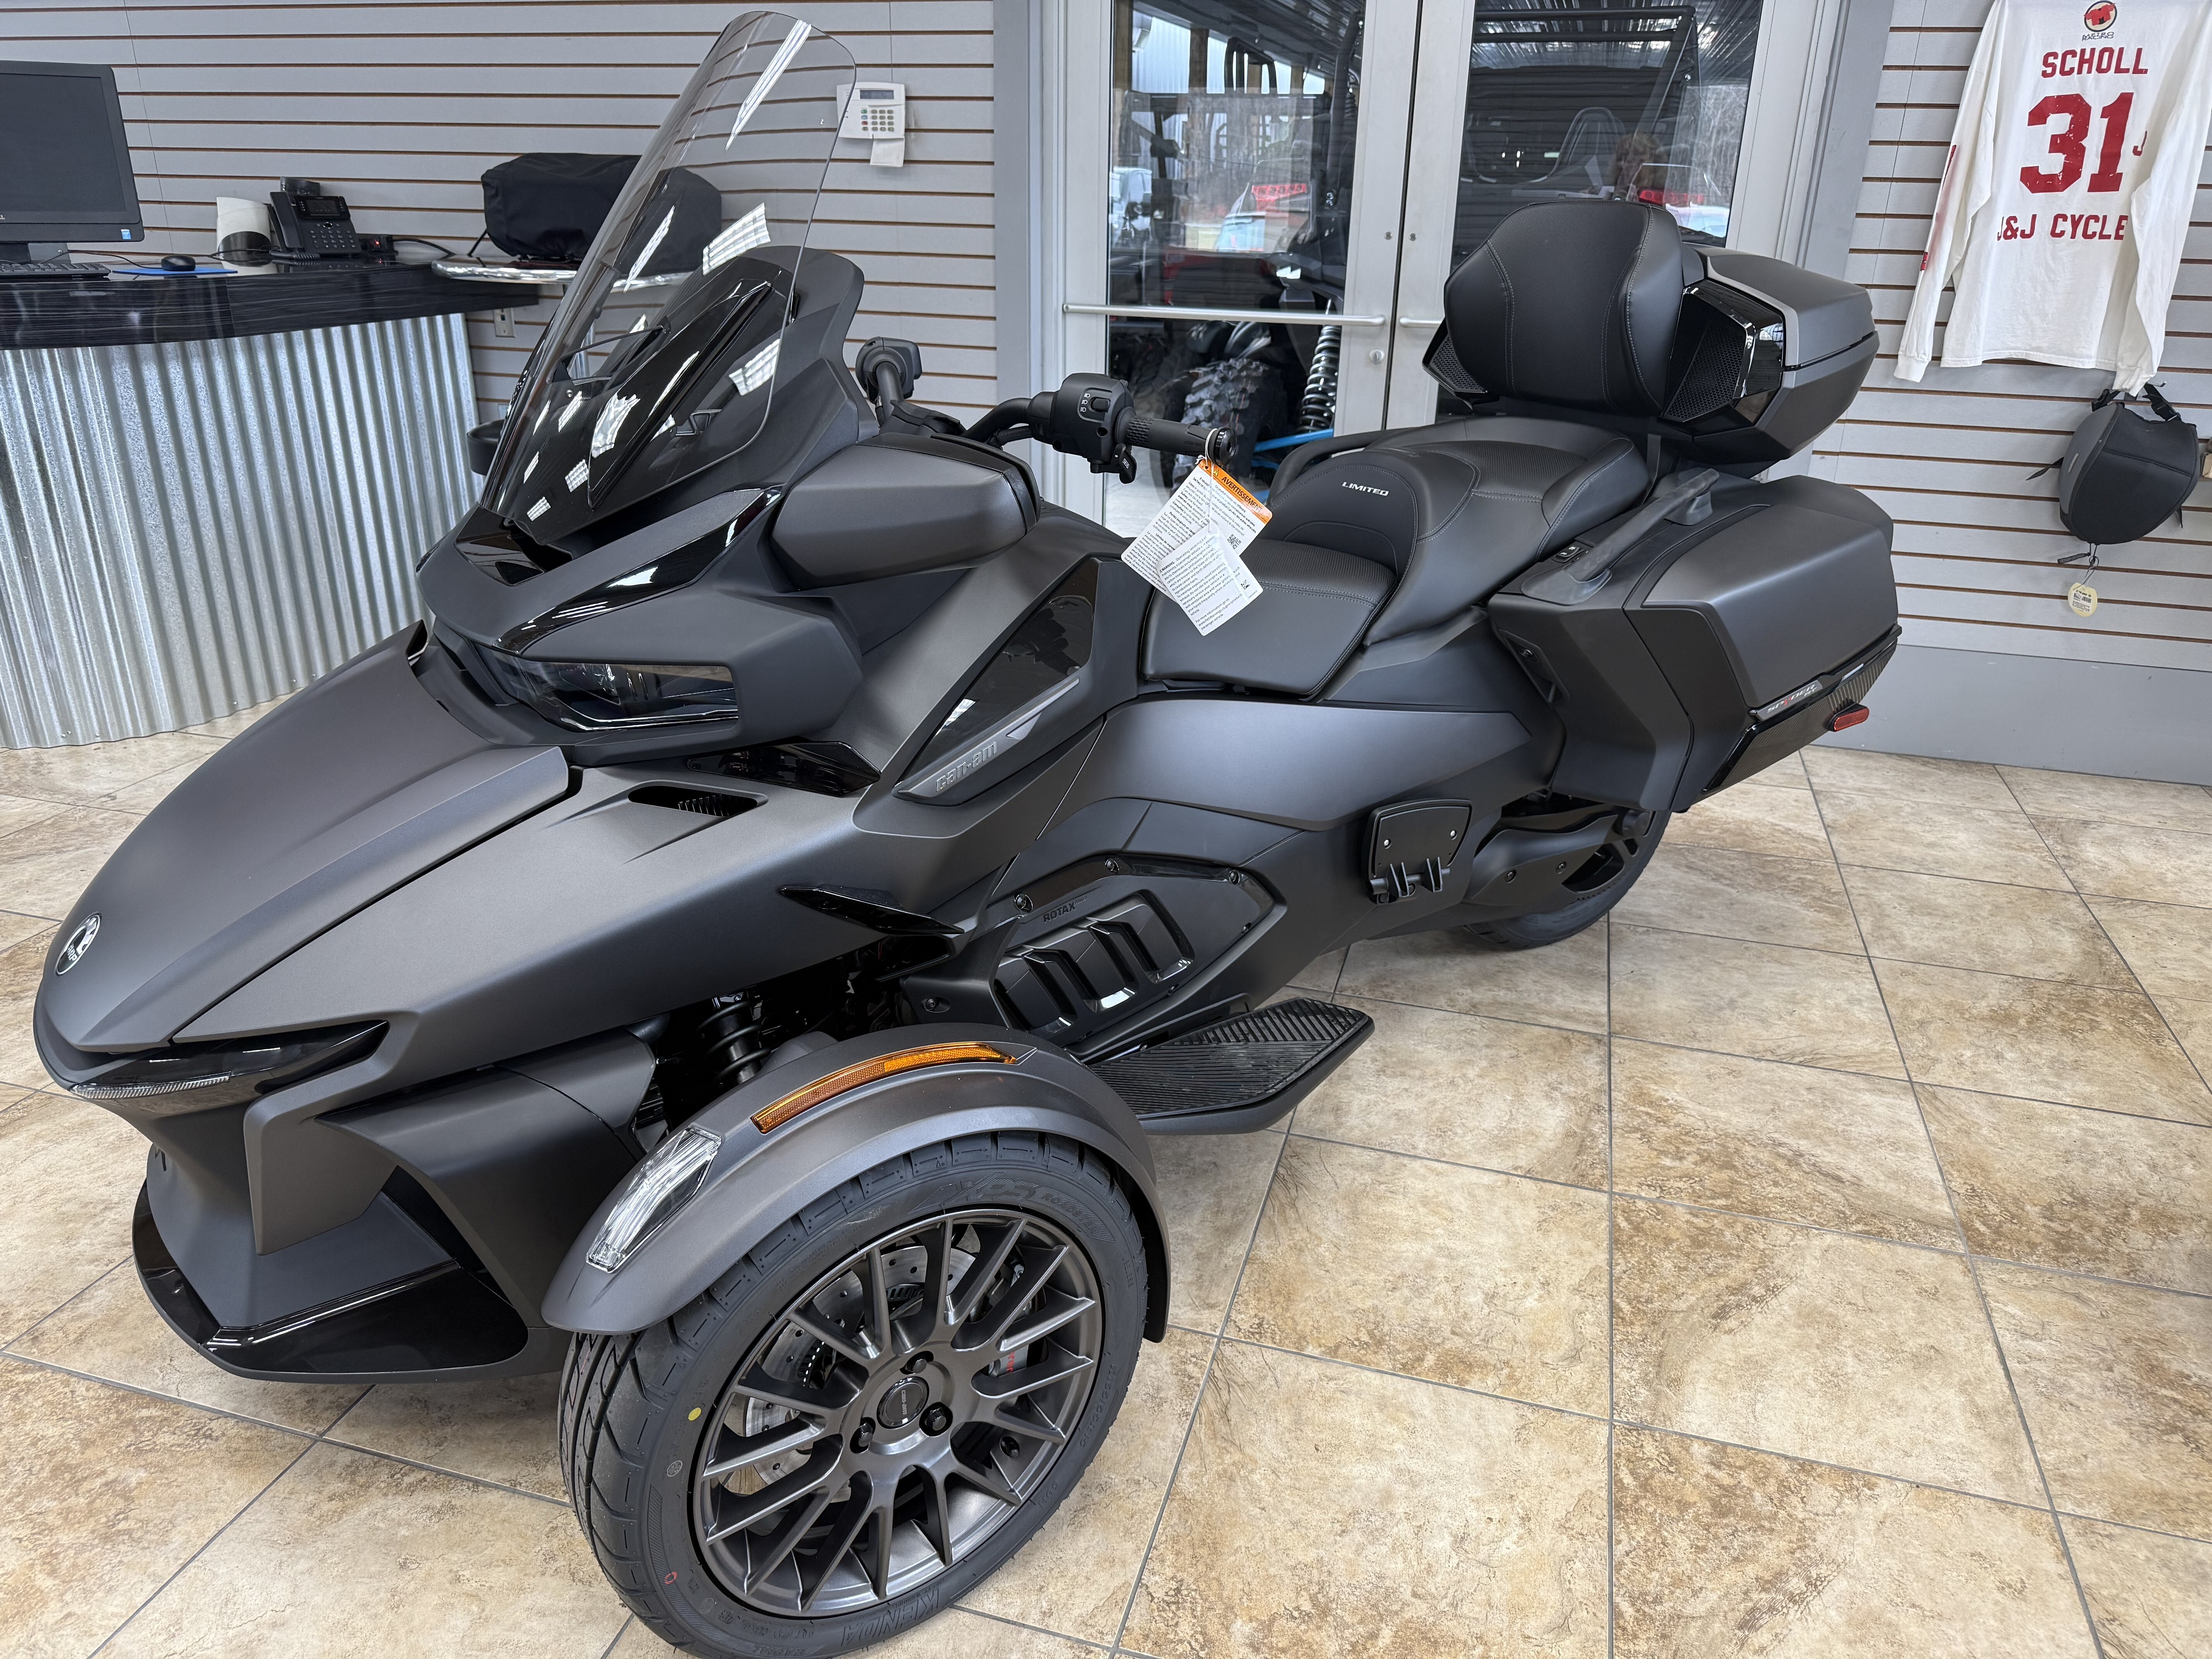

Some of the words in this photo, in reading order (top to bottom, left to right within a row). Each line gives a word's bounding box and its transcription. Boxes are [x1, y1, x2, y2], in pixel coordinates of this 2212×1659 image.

[2041, 46, 2148, 79] SCHOLL
[2020, 92, 2135, 194] 31
[2132, 131, 2148, 156] J
[1997, 213, 2037, 241] J&J
[2050, 213, 2128, 240] CYCLE
[1222, 476, 1263, 512] AVERTISSEMENT
[1342, 482, 1389, 496] LIMITED
[1767, 684, 1815, 713] SPYDER
[1804, 687, 1817, 697] RT
[936, 741, 997, 792] can-am
[1043, 901, 1076, 922] ROTAX
[67, 945, 77, 962] BRP
[841, 1588, 942, 1647] KENDA
